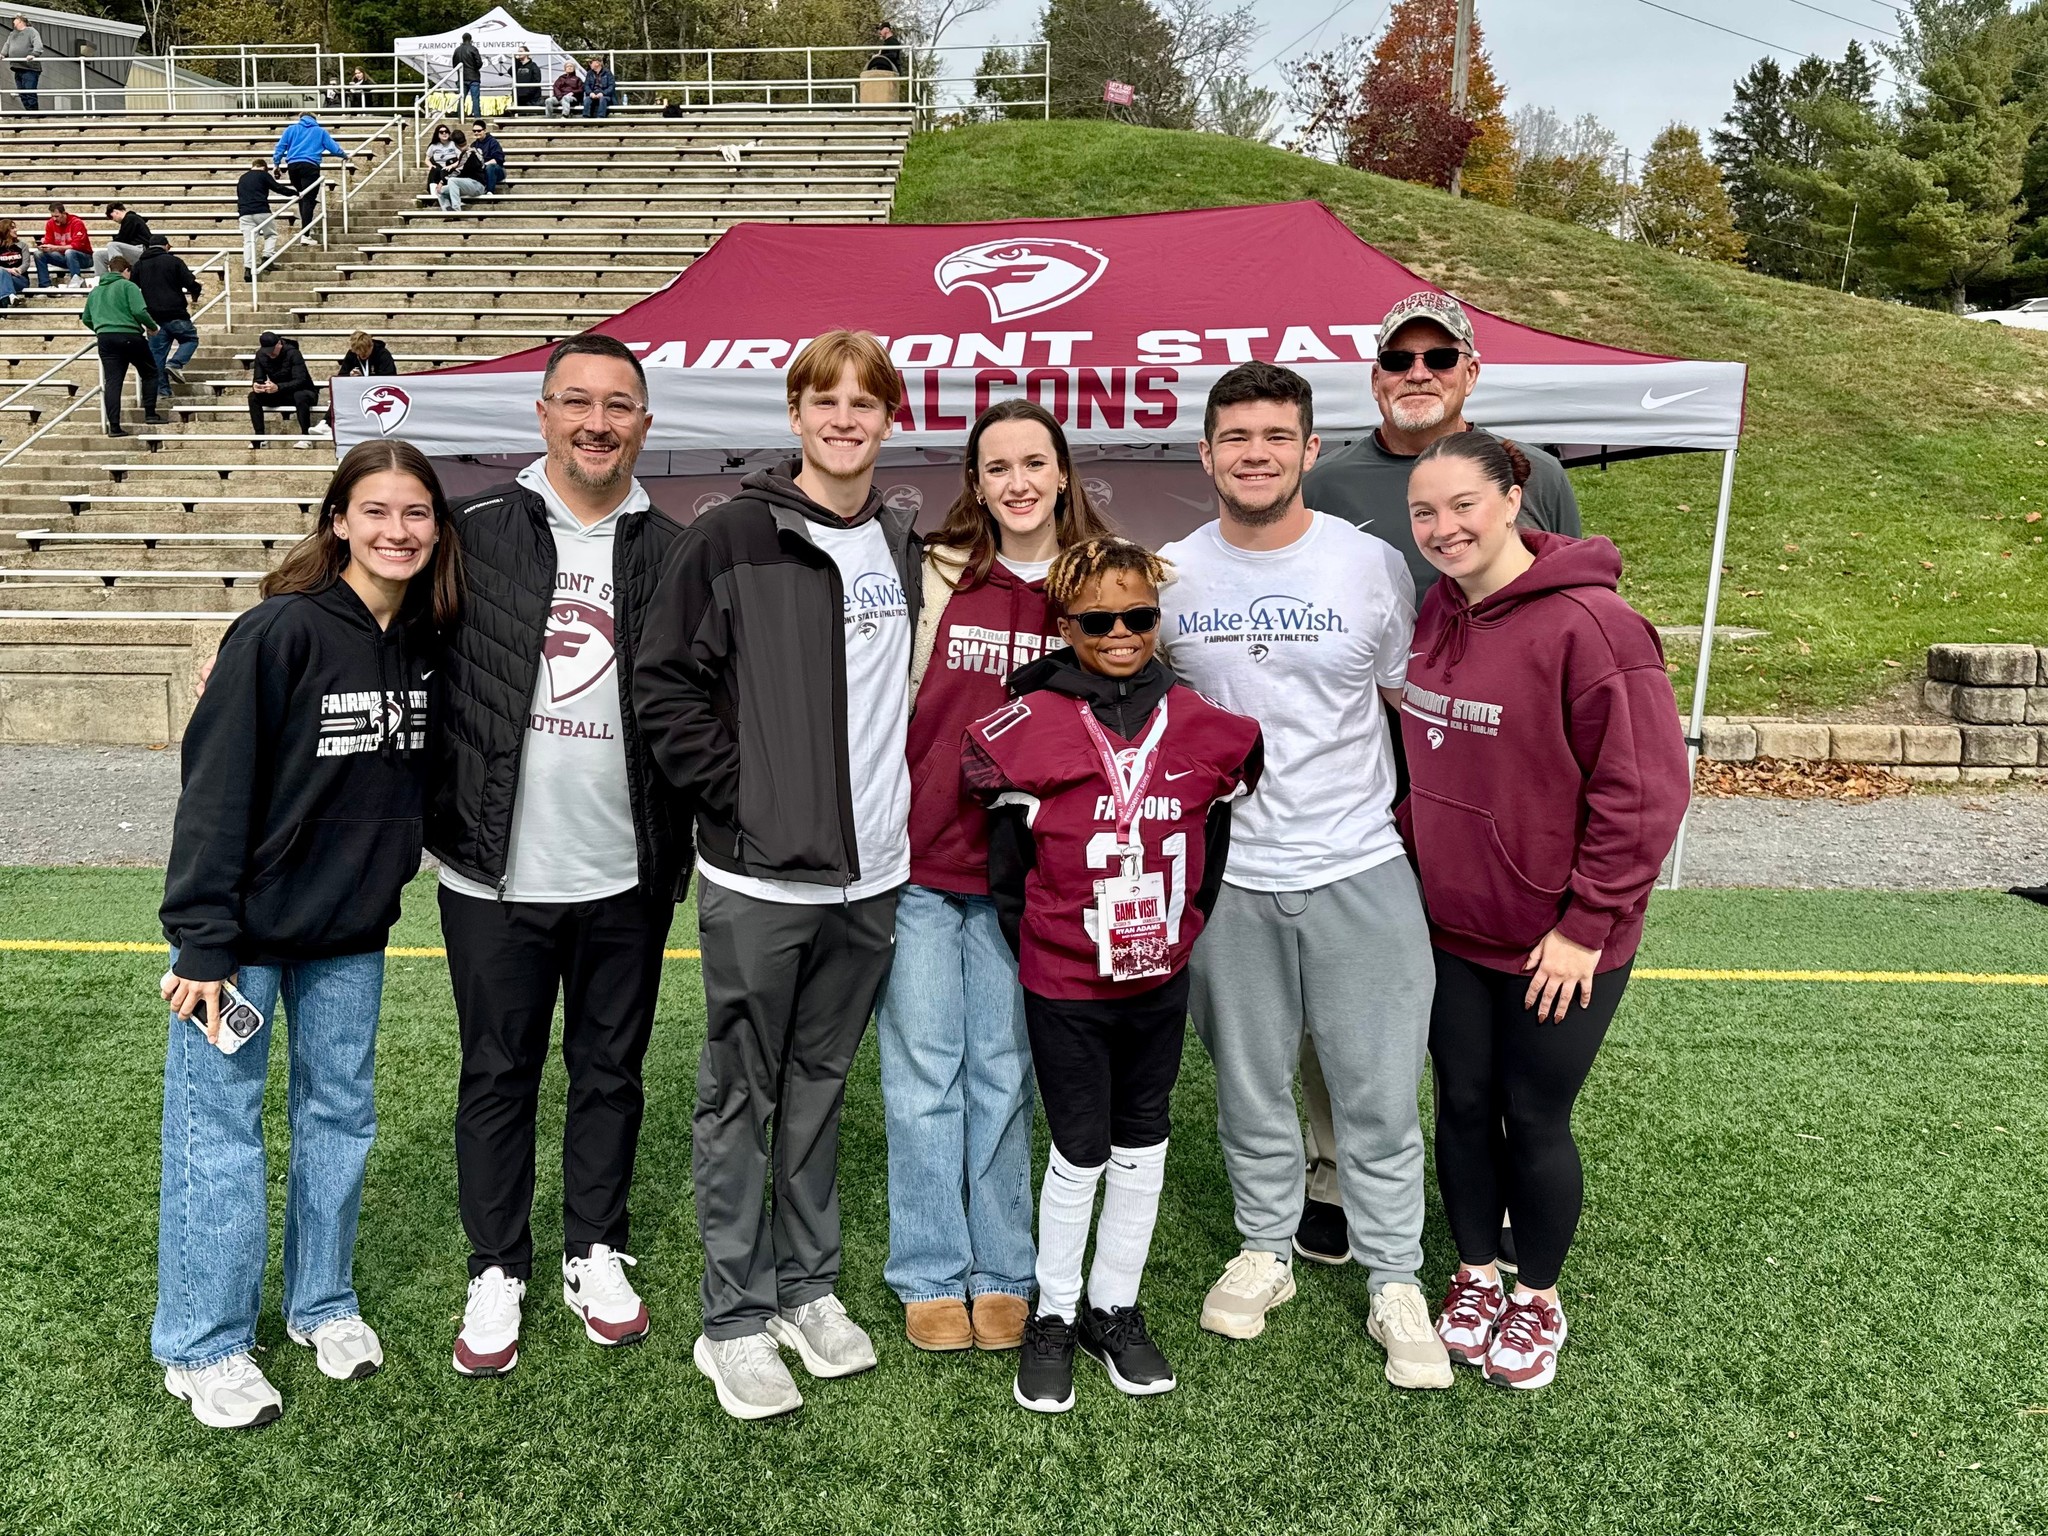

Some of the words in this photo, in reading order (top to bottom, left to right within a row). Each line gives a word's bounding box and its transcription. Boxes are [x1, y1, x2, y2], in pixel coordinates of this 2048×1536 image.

[418, 42, 457, 50] FAIRMONT
[483, 41, 527, 49] UNIVERSITY
[624, 330, 1093, 369] AIRONT
[1136, 324, 1480, 365] STAT
[1027, 635, 1061, 649] STTE
[1204, 634, 1245, 644] FAIRMONT
[1246, 634, 1273, 643] STATE
[1274, 633, 1319, 643] ATHLETICS
[1451, 698, 1504, 726] STATE
[1092, 795, 1182, 821] FAONS
[1114, 901, 1138, 922] GAME
[1137, 898, 1158, 919] VISIT
[1115, 928, 1136, 936] RYAN
